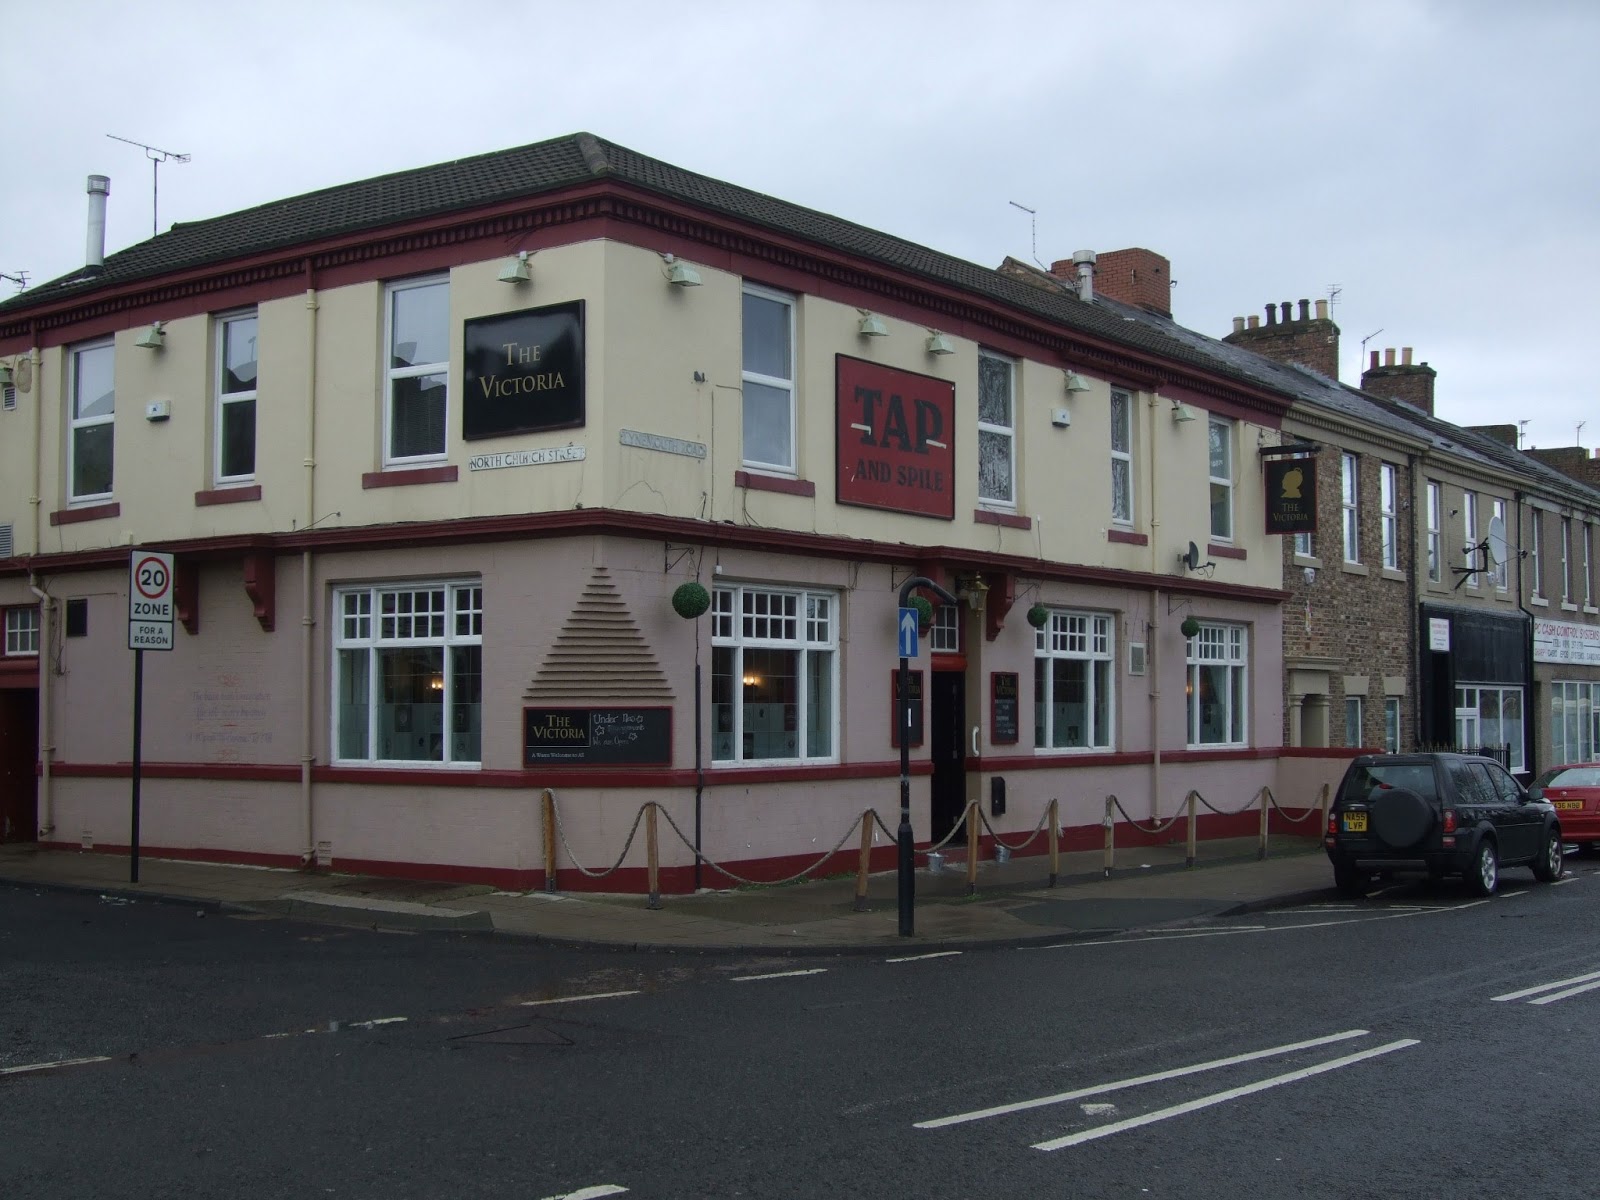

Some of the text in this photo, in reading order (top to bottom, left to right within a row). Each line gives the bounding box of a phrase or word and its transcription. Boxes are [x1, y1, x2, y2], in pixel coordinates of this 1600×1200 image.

[503, 342, 541, 366] THE
[479, 371, 565, 399] VICTORIA
[854, 385, 943, 455] TAP
[470, 456, 502, 469] NORTH
[505, 451, 545, 466] CHURCH
[855, 459, 943, 492] AND SPILE
[1282, 503, 1299, 512] THE
[1273, 513, 1308, 522] VICTORIA
[141, 569, 165, 587] 20
[134, 603, 169, 616] ZONE
[140, 626, 163, 635] FOR A
[1542, 623, 1556, 636] CASH
[1557, 626, 1577, 638] CONTROL
[1579, 628, 1600, 641] SYSTEMS
[134, 636, 168, 645] REASON
[545, 715, 570, 727] THE
[593, 713, 619, 724] Under
[532, 726, 585, 739] VICTORIA
[1348, 821, 1363, 829] LVR
